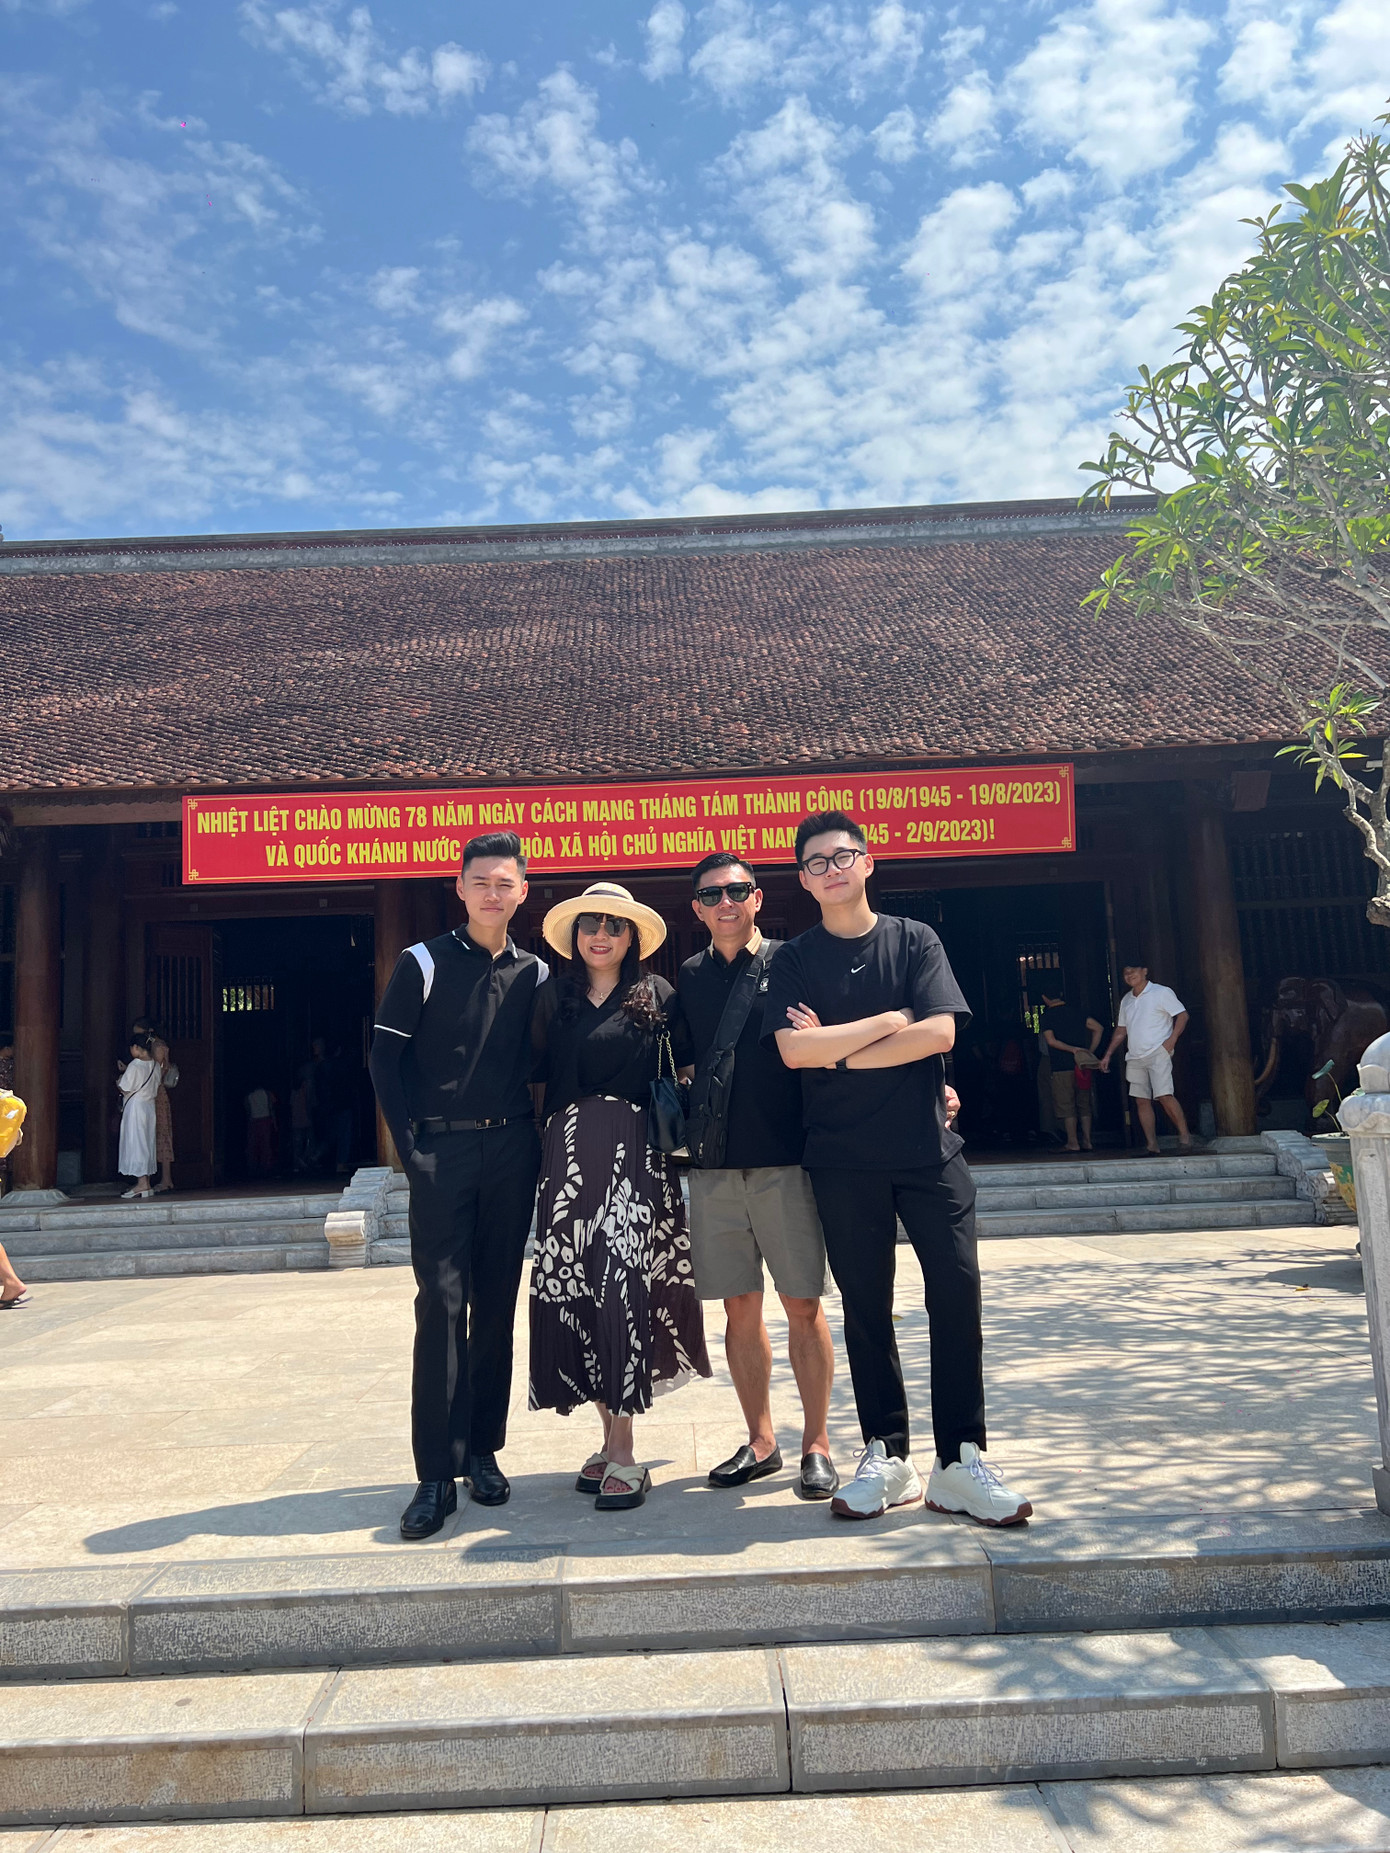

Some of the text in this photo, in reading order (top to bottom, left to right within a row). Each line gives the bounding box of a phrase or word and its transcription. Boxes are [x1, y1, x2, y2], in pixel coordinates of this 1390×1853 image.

[198, 808, 248, 837] NHIỆT
[254, 806, 289, 836] LIỆT
[295, 805, 341, 830] CHÀO
[348, 803, 400, 829] MỪNG
[406, 807, 426, 827] 78
[433, 801, 473, 826] NĂM
[479, 799, 524, 824] NGÀY
[531, 798, 577, 823] CÁCH
[583, 800, 634, 826] MẠNG
[640, 794, 696, 819] THÁNG
[702, 792, 738, 816] TÁM
[744, 789, 800, 814] THÀNH
[807, 787, 853, 812] CÔNG
[860, 786, 951, 812] (19/8/1945
[970, 782, 1060, 805] 19/8/2023)
[266, 841, 288, 866] VÀ
[294, 837, 341, 868] QUỐC
[347, 839, 407, 864] KHÁNH
[413, 837, 460, 862] NƯỚC
[520, 833, 554, 859] HÒA
[560, 833, 583, 857] XÃ
[589, 831, 617, 860] HỘI
[623, 827, 657, 855] CHỦ
[663, 827, 715, 853] NGHĨA
[721, 825, 756, 854] VIỆT
[907, 819, 994, 843] 2/9/2023)!
